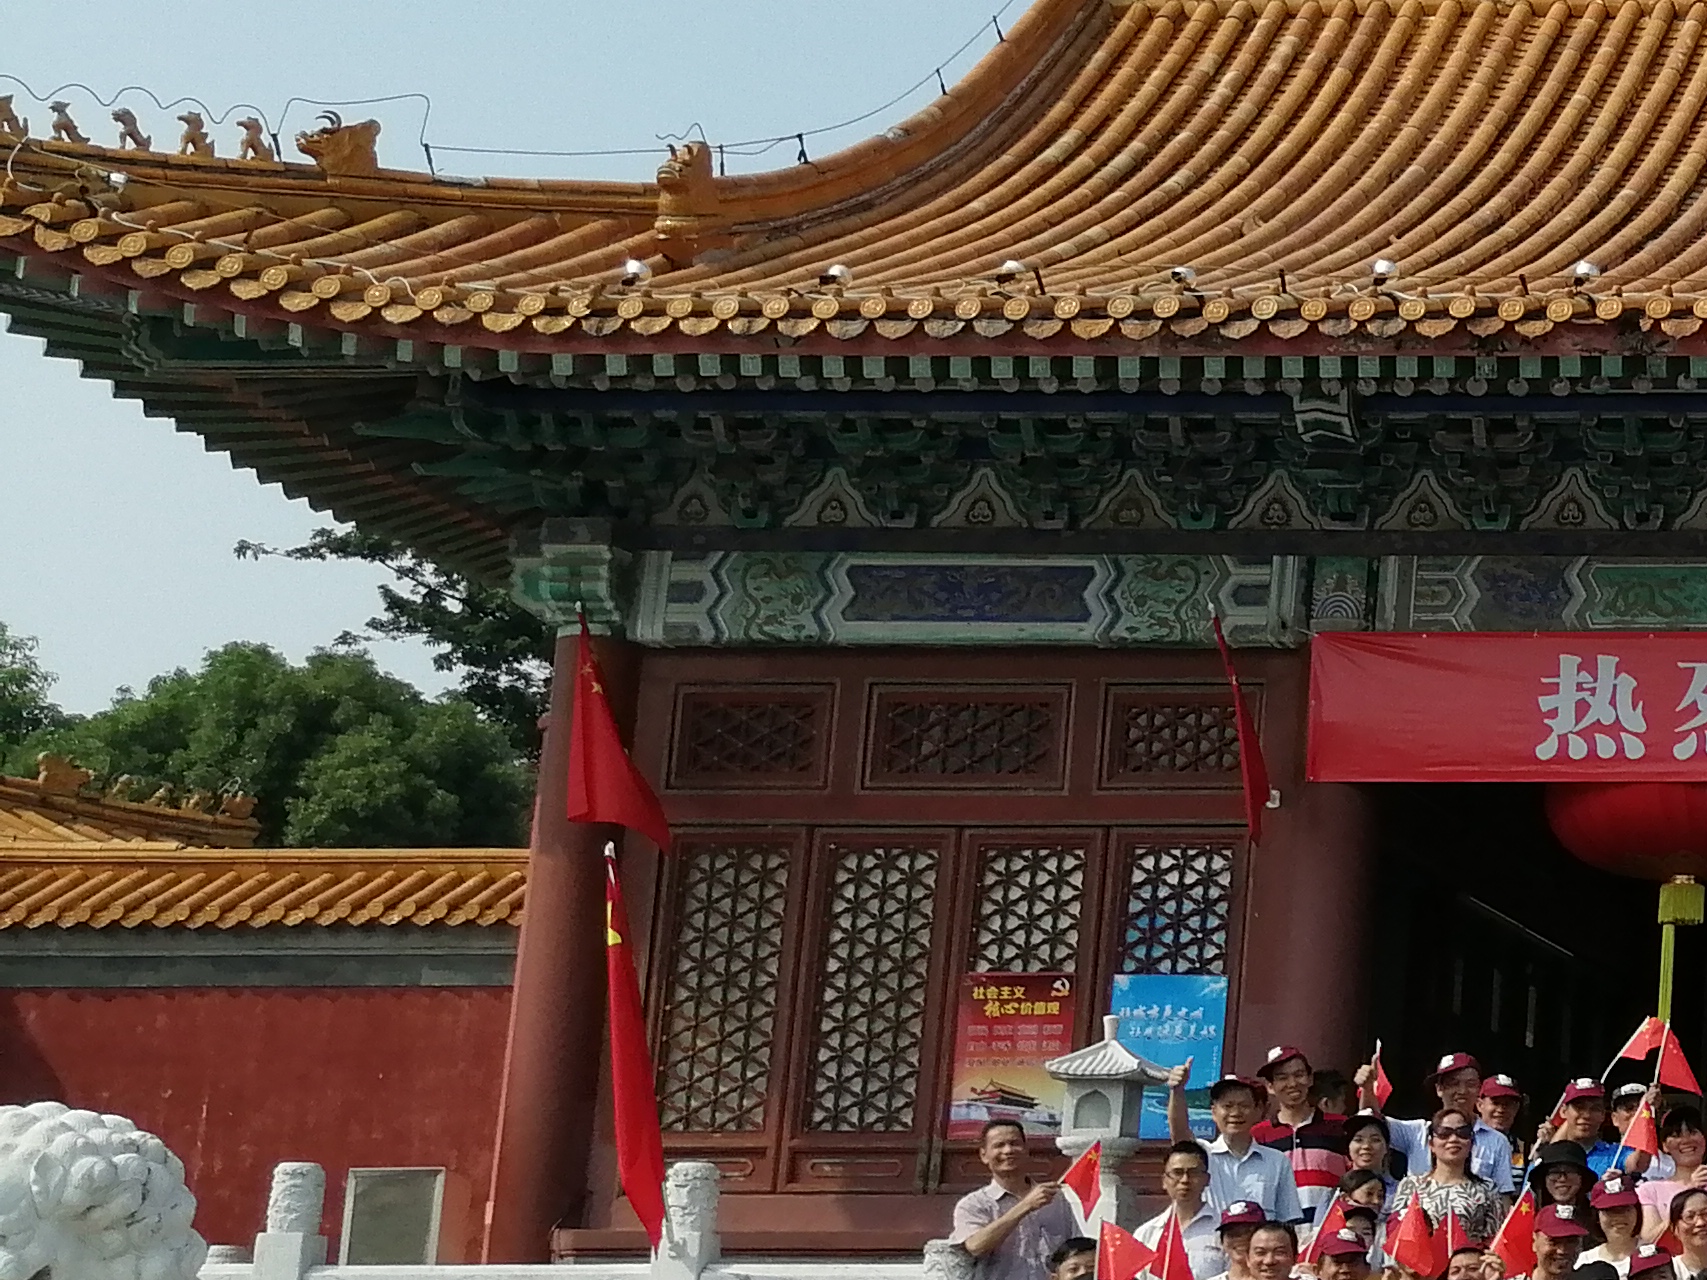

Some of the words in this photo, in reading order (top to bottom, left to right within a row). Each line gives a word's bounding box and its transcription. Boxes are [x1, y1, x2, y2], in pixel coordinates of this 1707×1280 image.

[973, 986, 1026, 999] 社会主义
[983, 1000, 1059, 1018] 核心价值观
